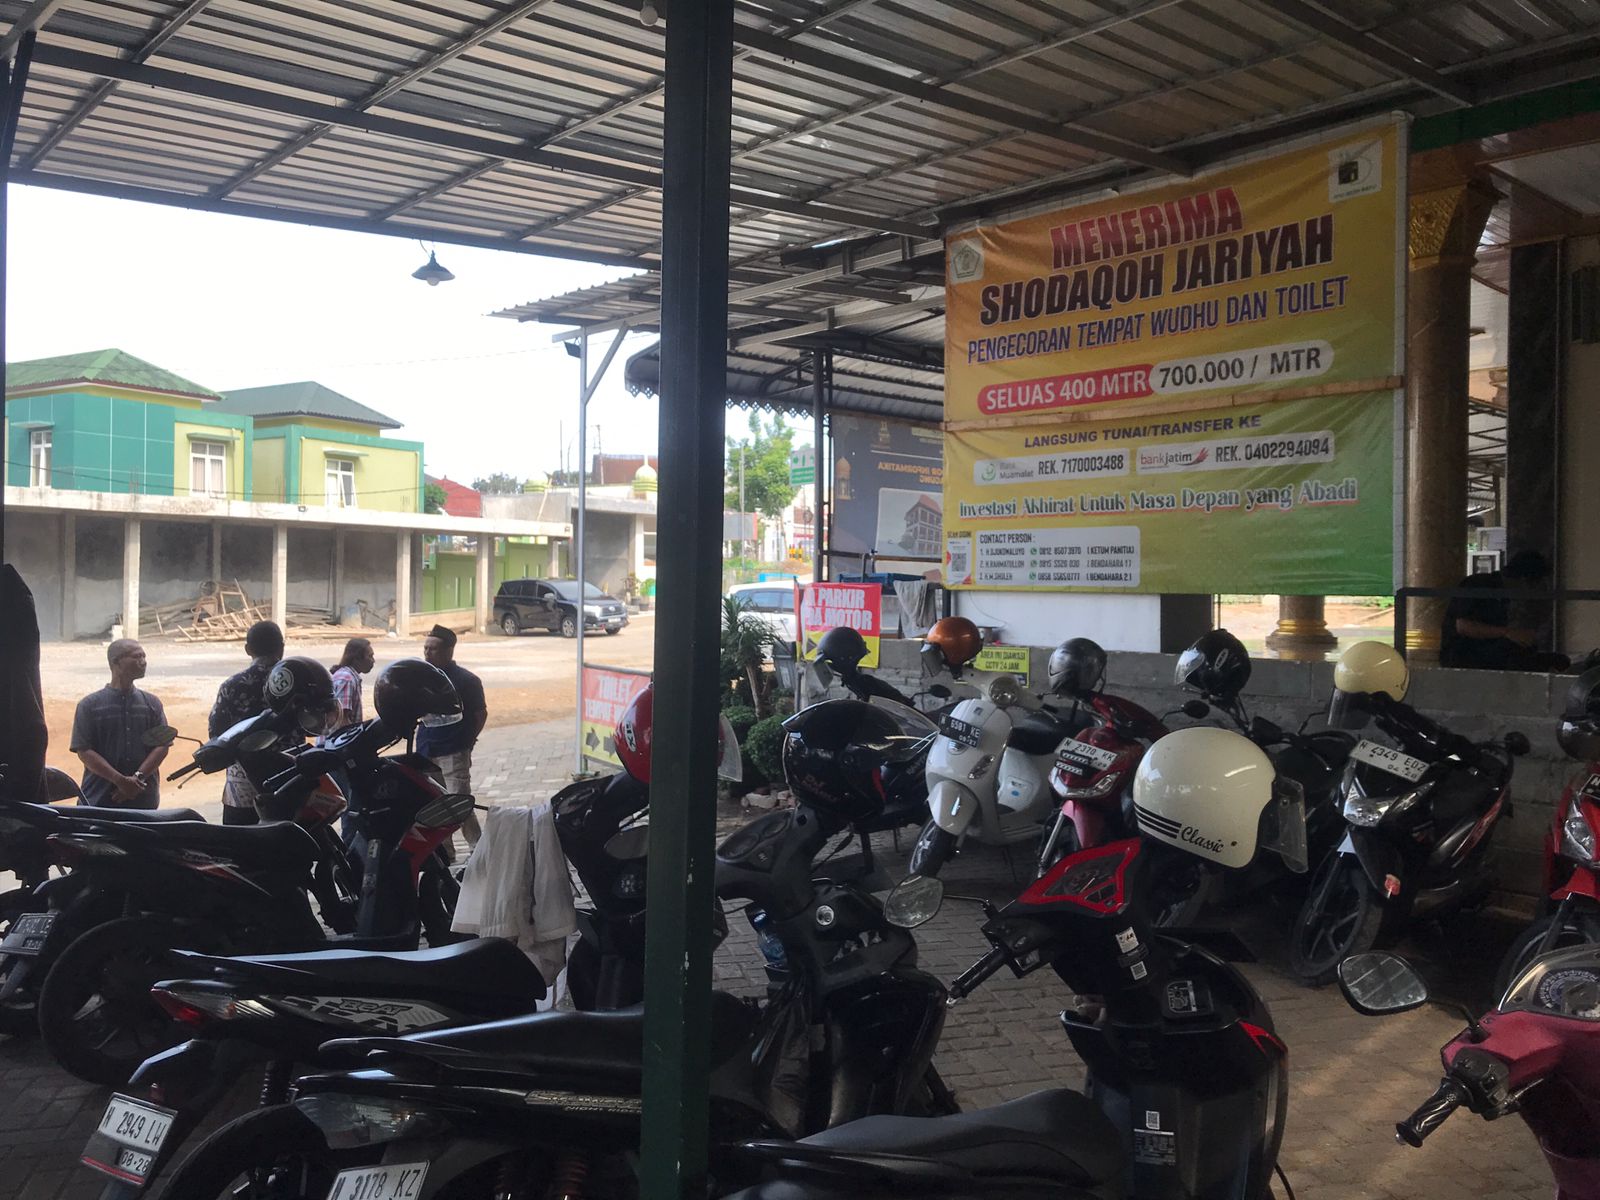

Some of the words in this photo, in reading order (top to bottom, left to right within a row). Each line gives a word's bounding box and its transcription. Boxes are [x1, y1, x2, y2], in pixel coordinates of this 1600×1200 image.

[1050, 187, 1244, 269] MENERIMA
[981, 252, 1164, 326] SHODAQOH
[1171, 214, 1333, 293] JARIYAH
[968, 324, 1070, 363] PENGECORAN
[1077, 313, 1142, 350] TEMPAT
[1151, 297, 1219, 337] WUDHU
[1226, 290, 1267, 323] DAN
[1276, 276, 1349, 316] TOILET
[1159, 358, 1244, 388] 700.000
[1270, 347, 1321, 375] MTR
[986, 381, 1054, 411] SELUAS
[1060, 376, 1095, 400] 400
[1101, 370, 1148, 396] MTR
[1025, 431, 1097, 448] LANGSUNG
[1102, 416, 1234, 441] TUNAI/TRANSFER
[1238, 415, 1262, 429] KE
[1038, 459, 1060, 475] REK.
[1061, 454, 1124, 474] 7170003488
[1216, 444, 1242, 462] REK.
[1245, 437, 1329, 461] 0402294094
[960, 500, 1017, 518] Investasi
[1022, 497, 1075, 516] Akhirat
[1080, 492, 1126, 513] Untuk
[1130, 490, 1177, 511] Masa
[1182, 487, 1240, 512] Depan
[1244, 485, 1293, 510] yang
[1299, 478, 1358, 503] Abadi
[980, 533, 1006, 543] CONTACT
[1007, 532, 1032, 543] PERSON
[818, 588, 865, 610] PARKIR
[825, 607, 873, 631] MOTOR
[1074, 743, 1097, 756] 2370
[1360, 741, 1369, 750] N
[1371, 746, 1399, 761] 4349
[1181, 826, 1224, 853] Classic
[103, 1106, 116, 1129] N
[116, 1111, 146, 1139] 2949
[349, 1171, 388, 1200] 3178
[394, 1169, 421, 1197] KZ
